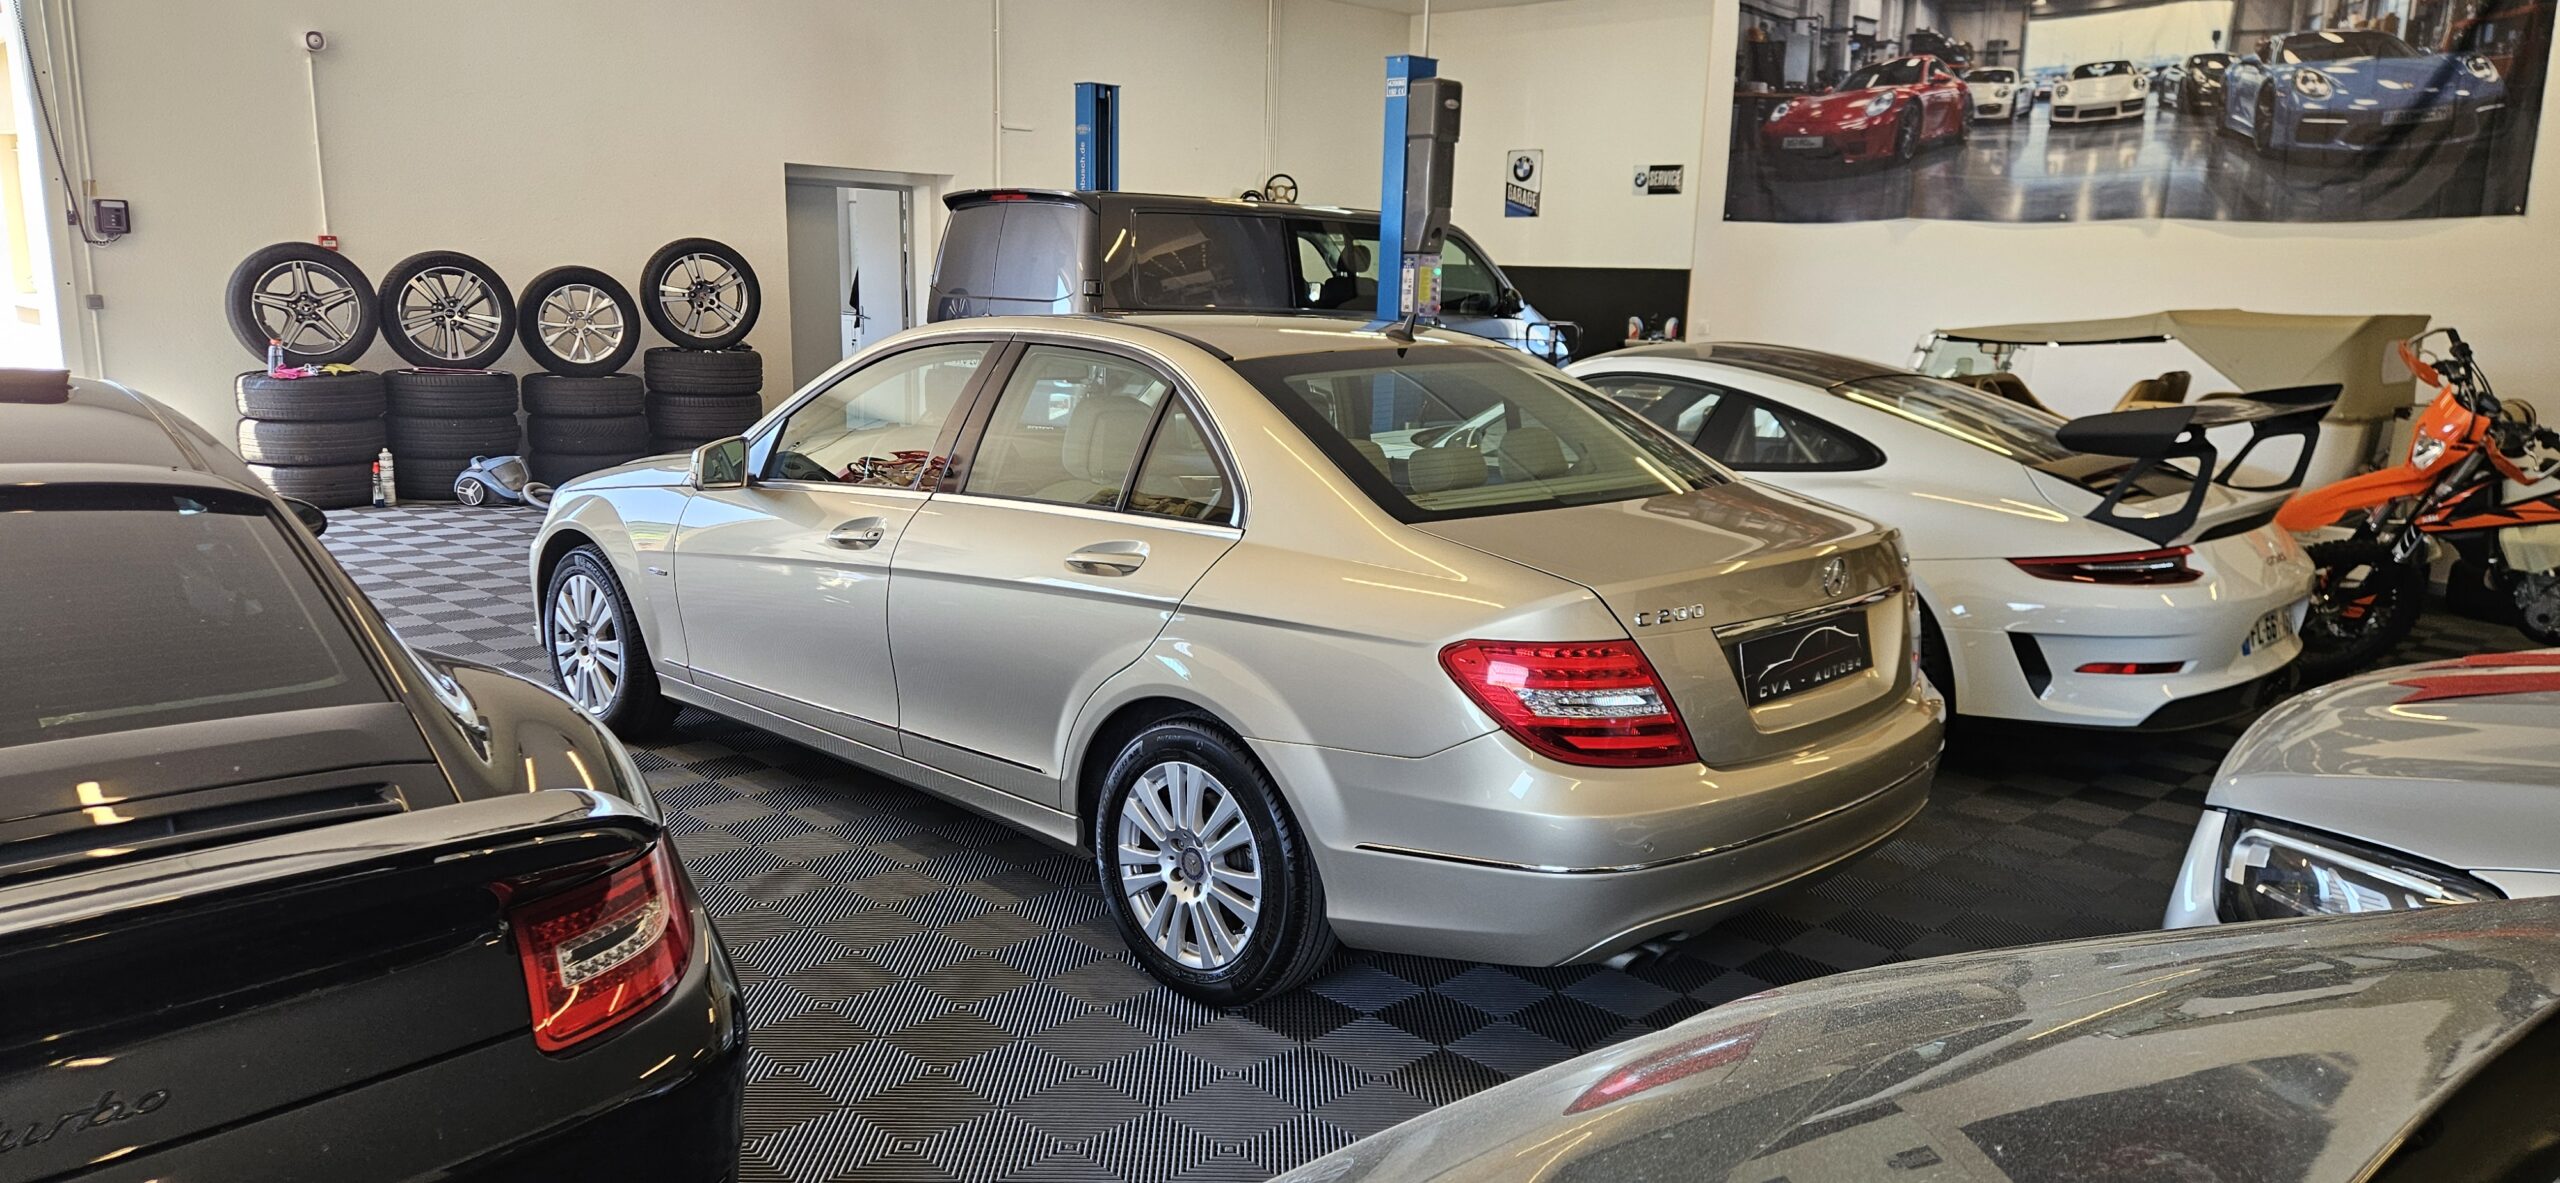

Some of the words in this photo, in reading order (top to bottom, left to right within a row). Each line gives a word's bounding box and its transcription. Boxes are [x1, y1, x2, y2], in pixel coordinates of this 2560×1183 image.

[1649, 170, 1681, 187] SERVICE
[1507, 184, 1538, 210] GARAGE
[1634, 611, 1652, 627] C
[1656, 603, 1705, 625] 200
[1759, 680, 1792, 698] CVA
[0, 1088, 171, 1154] urbo
